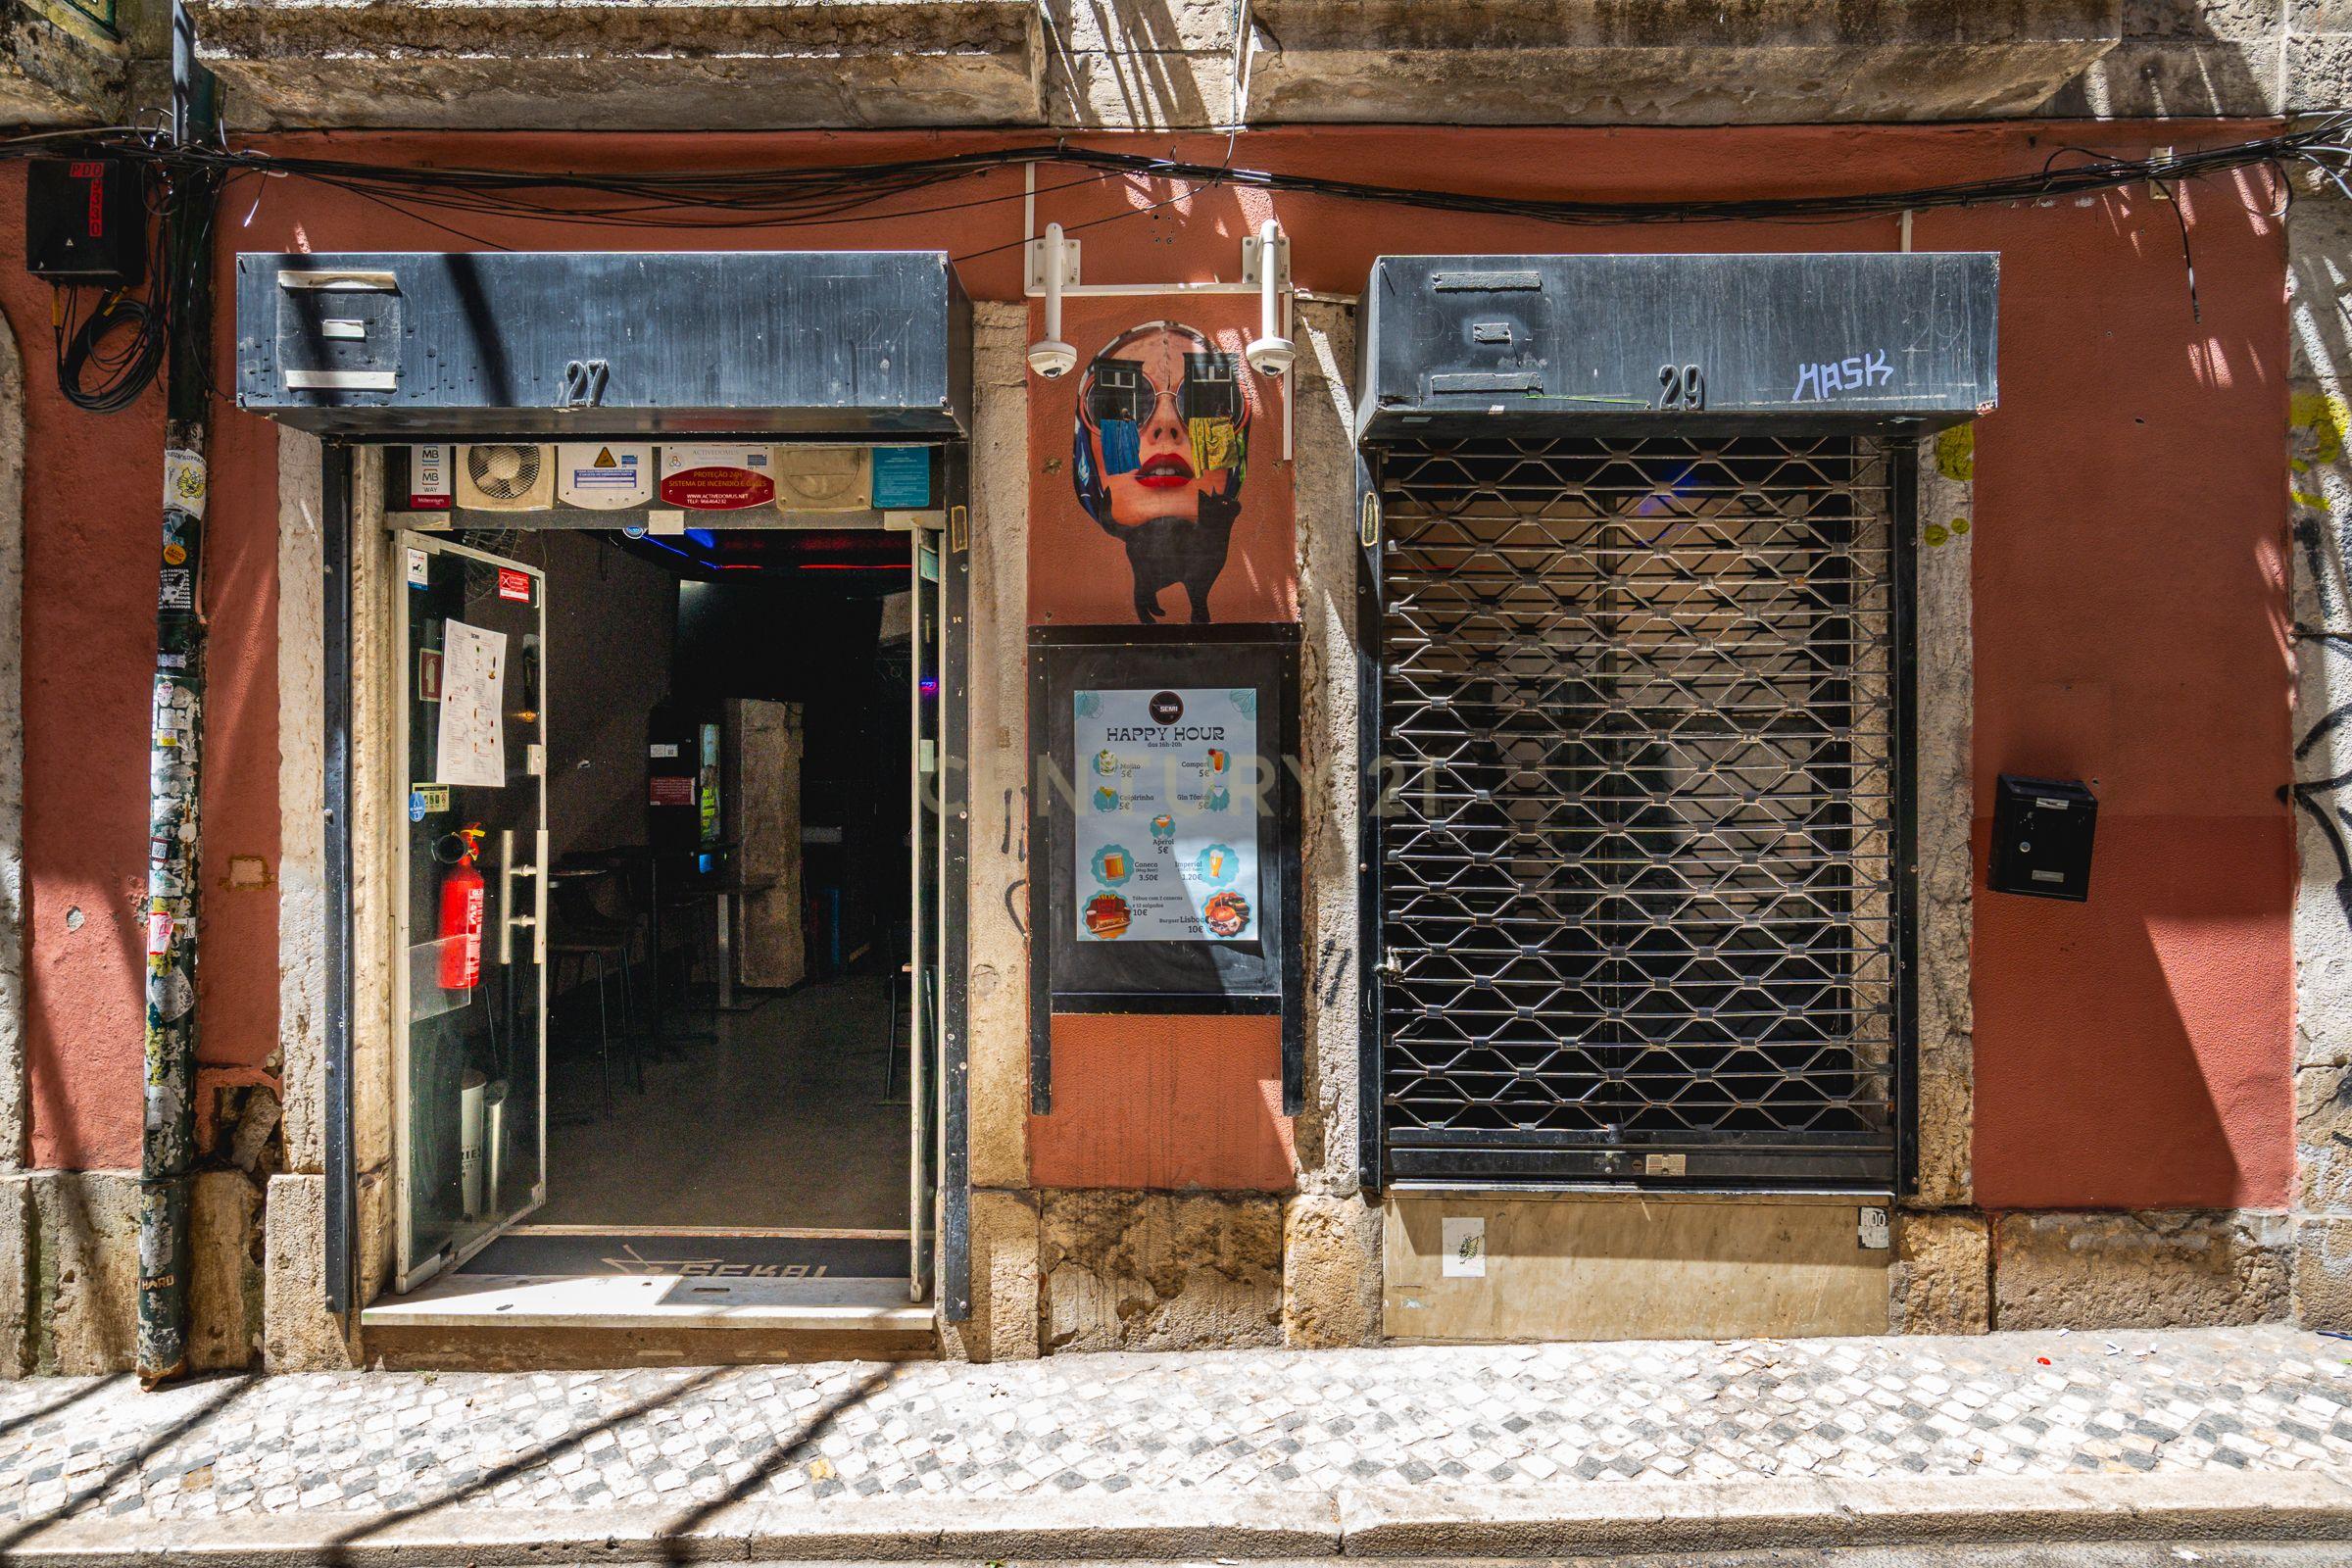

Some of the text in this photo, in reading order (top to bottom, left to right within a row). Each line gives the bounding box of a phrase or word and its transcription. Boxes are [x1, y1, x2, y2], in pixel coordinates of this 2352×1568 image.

[1791, 349, 1894, 402] MASK
[565, 360, 610, 408] 27
[1659, 360, 1705, 412] 29
[422, 450, 439, 459] MB
[422, 472, 439, 481] MB
[1106, 726, 1225, 742] HAPPY HOUR
[1152, 838, 1175, 847] Aperol
[1157, 846, 1169, 855] 5€
[1188, 925, 1203, 934] 10€
